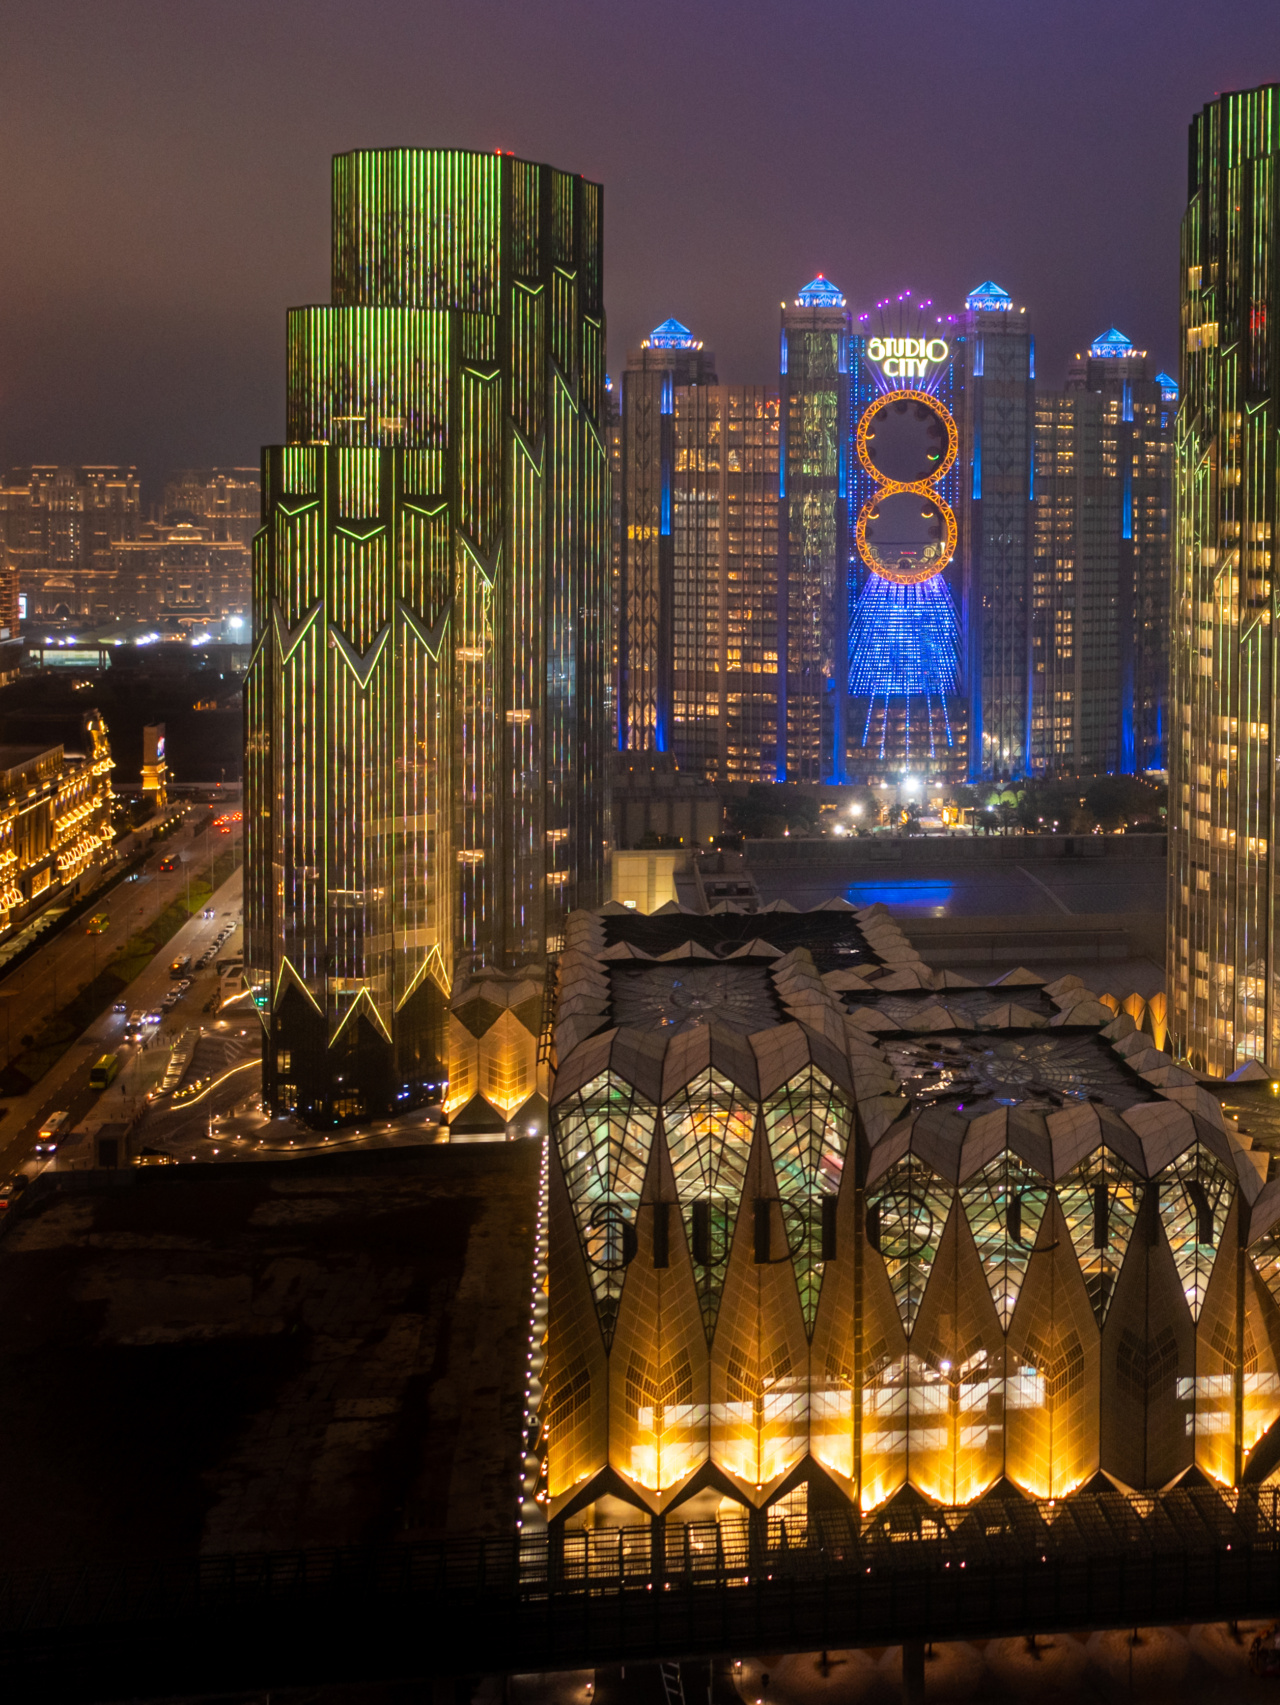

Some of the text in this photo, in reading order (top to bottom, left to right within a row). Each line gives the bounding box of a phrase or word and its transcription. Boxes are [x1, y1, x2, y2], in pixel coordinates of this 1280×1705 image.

[869, 338, 948, 361] STUDIO
[884, 359, 928, 377] CITY
[587, 1179, 1226, 1271] STUDIO CITY
